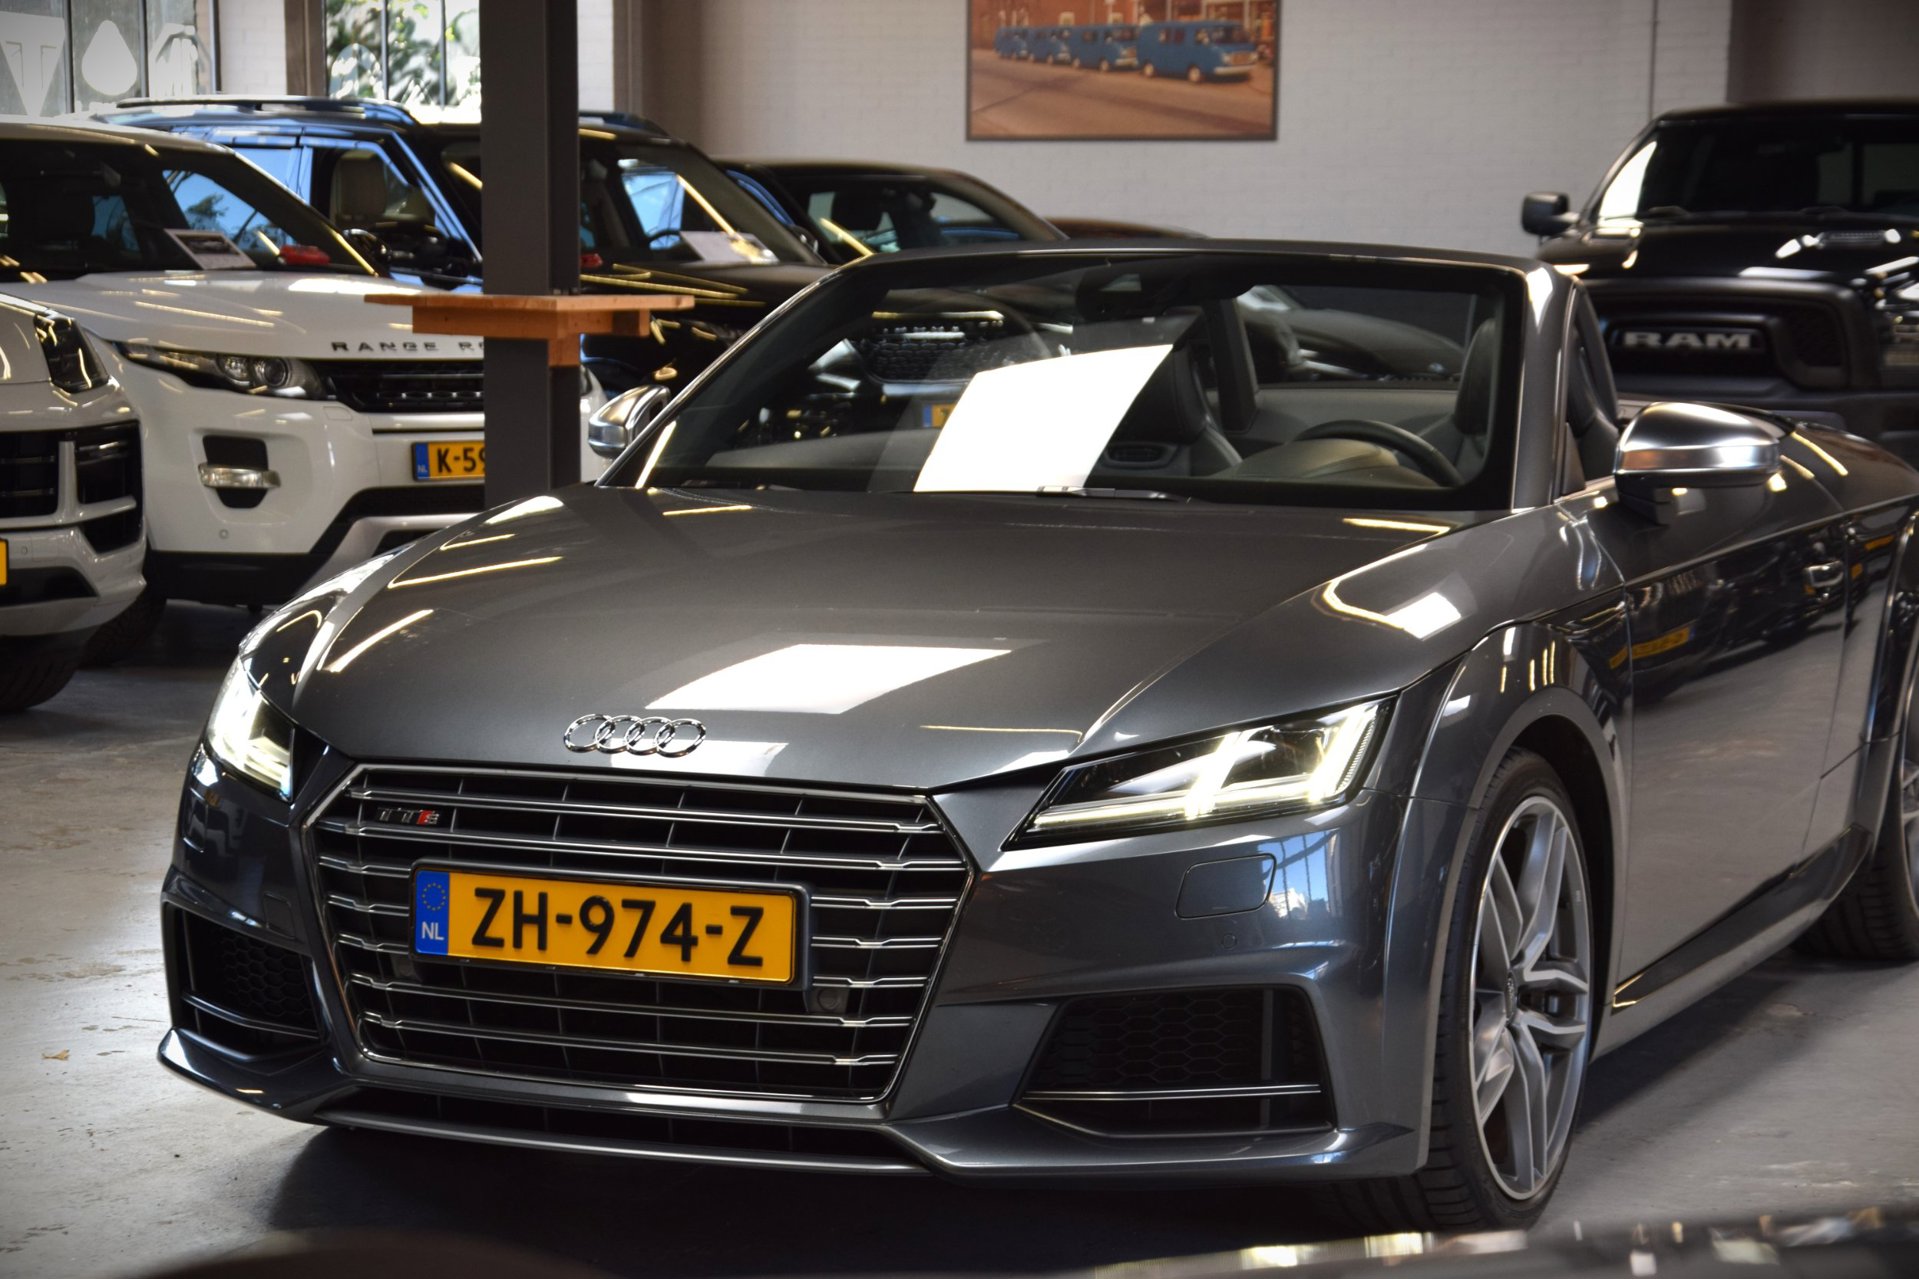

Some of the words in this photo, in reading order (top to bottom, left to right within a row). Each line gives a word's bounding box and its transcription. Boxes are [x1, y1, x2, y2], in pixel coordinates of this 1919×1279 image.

[331, 341, 438, 352] RANGE
[1624, 332, 1750, 348] RAM
[378, 808, 440, 825] TTS
[421, 921, 445, 941] NL
[471, 887, 764, 968] ZH-974-Z
